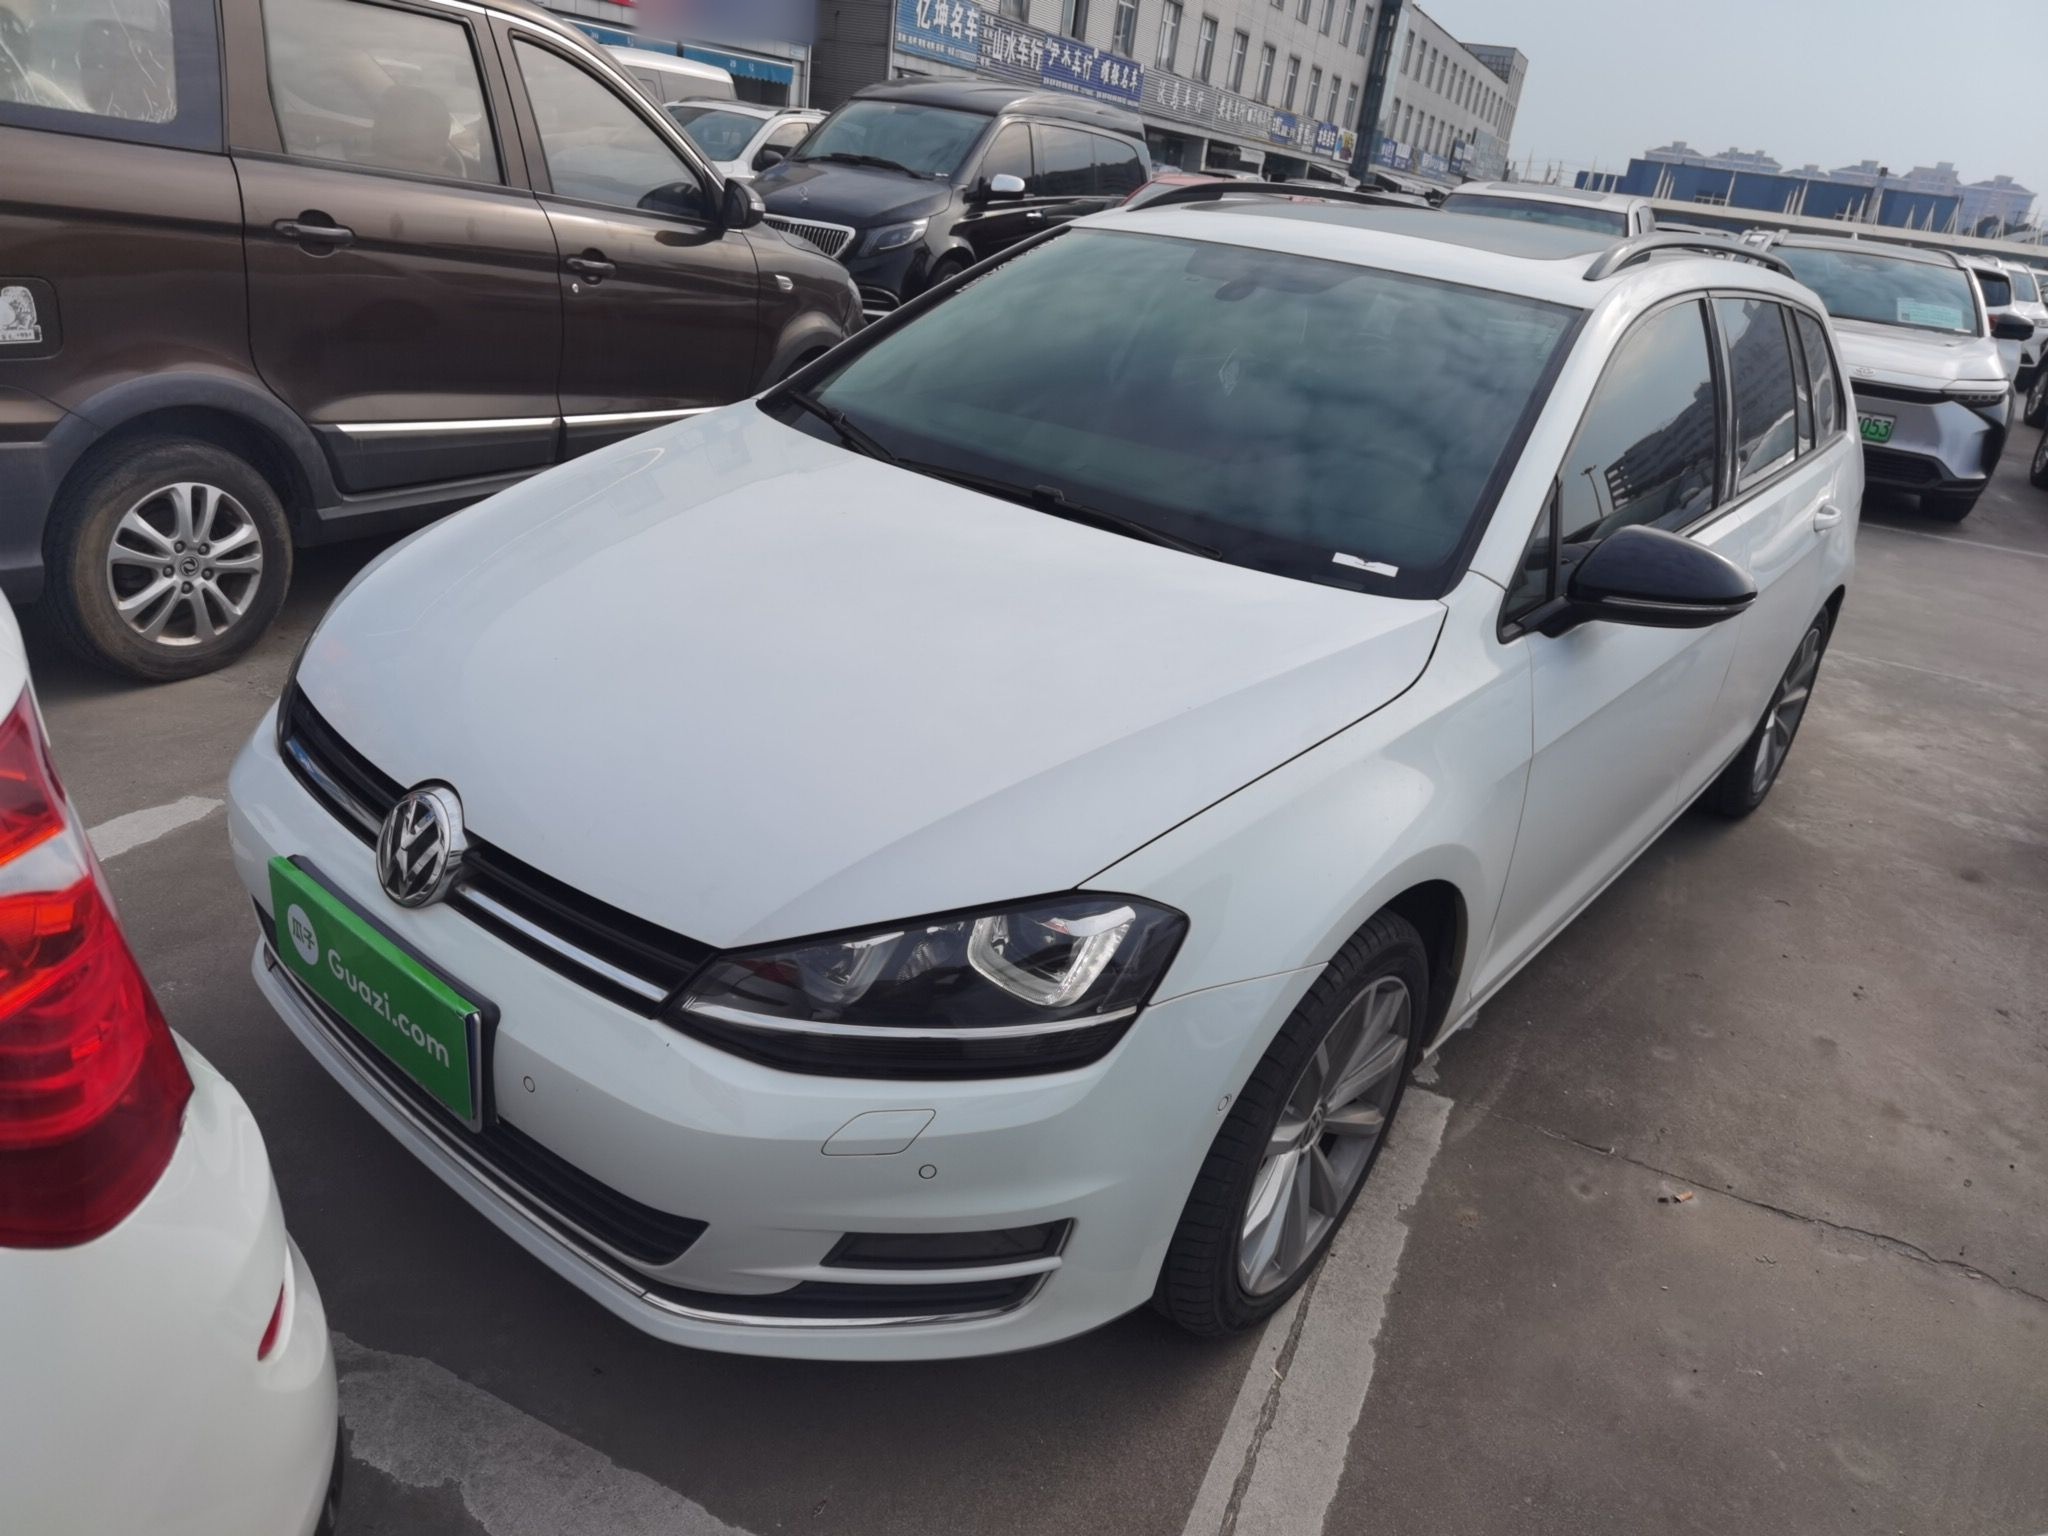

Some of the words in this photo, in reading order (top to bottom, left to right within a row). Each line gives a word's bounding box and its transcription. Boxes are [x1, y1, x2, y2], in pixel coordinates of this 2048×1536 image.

[916, 0, 978, 43] 亿坤名车
[992, 27, 1044, 71] 山水车行
[1859, 416, 1892, 437] 053
[291, 917, 315, 951] 瓜子
[327, 948, 451, 1068] Guazi.com
